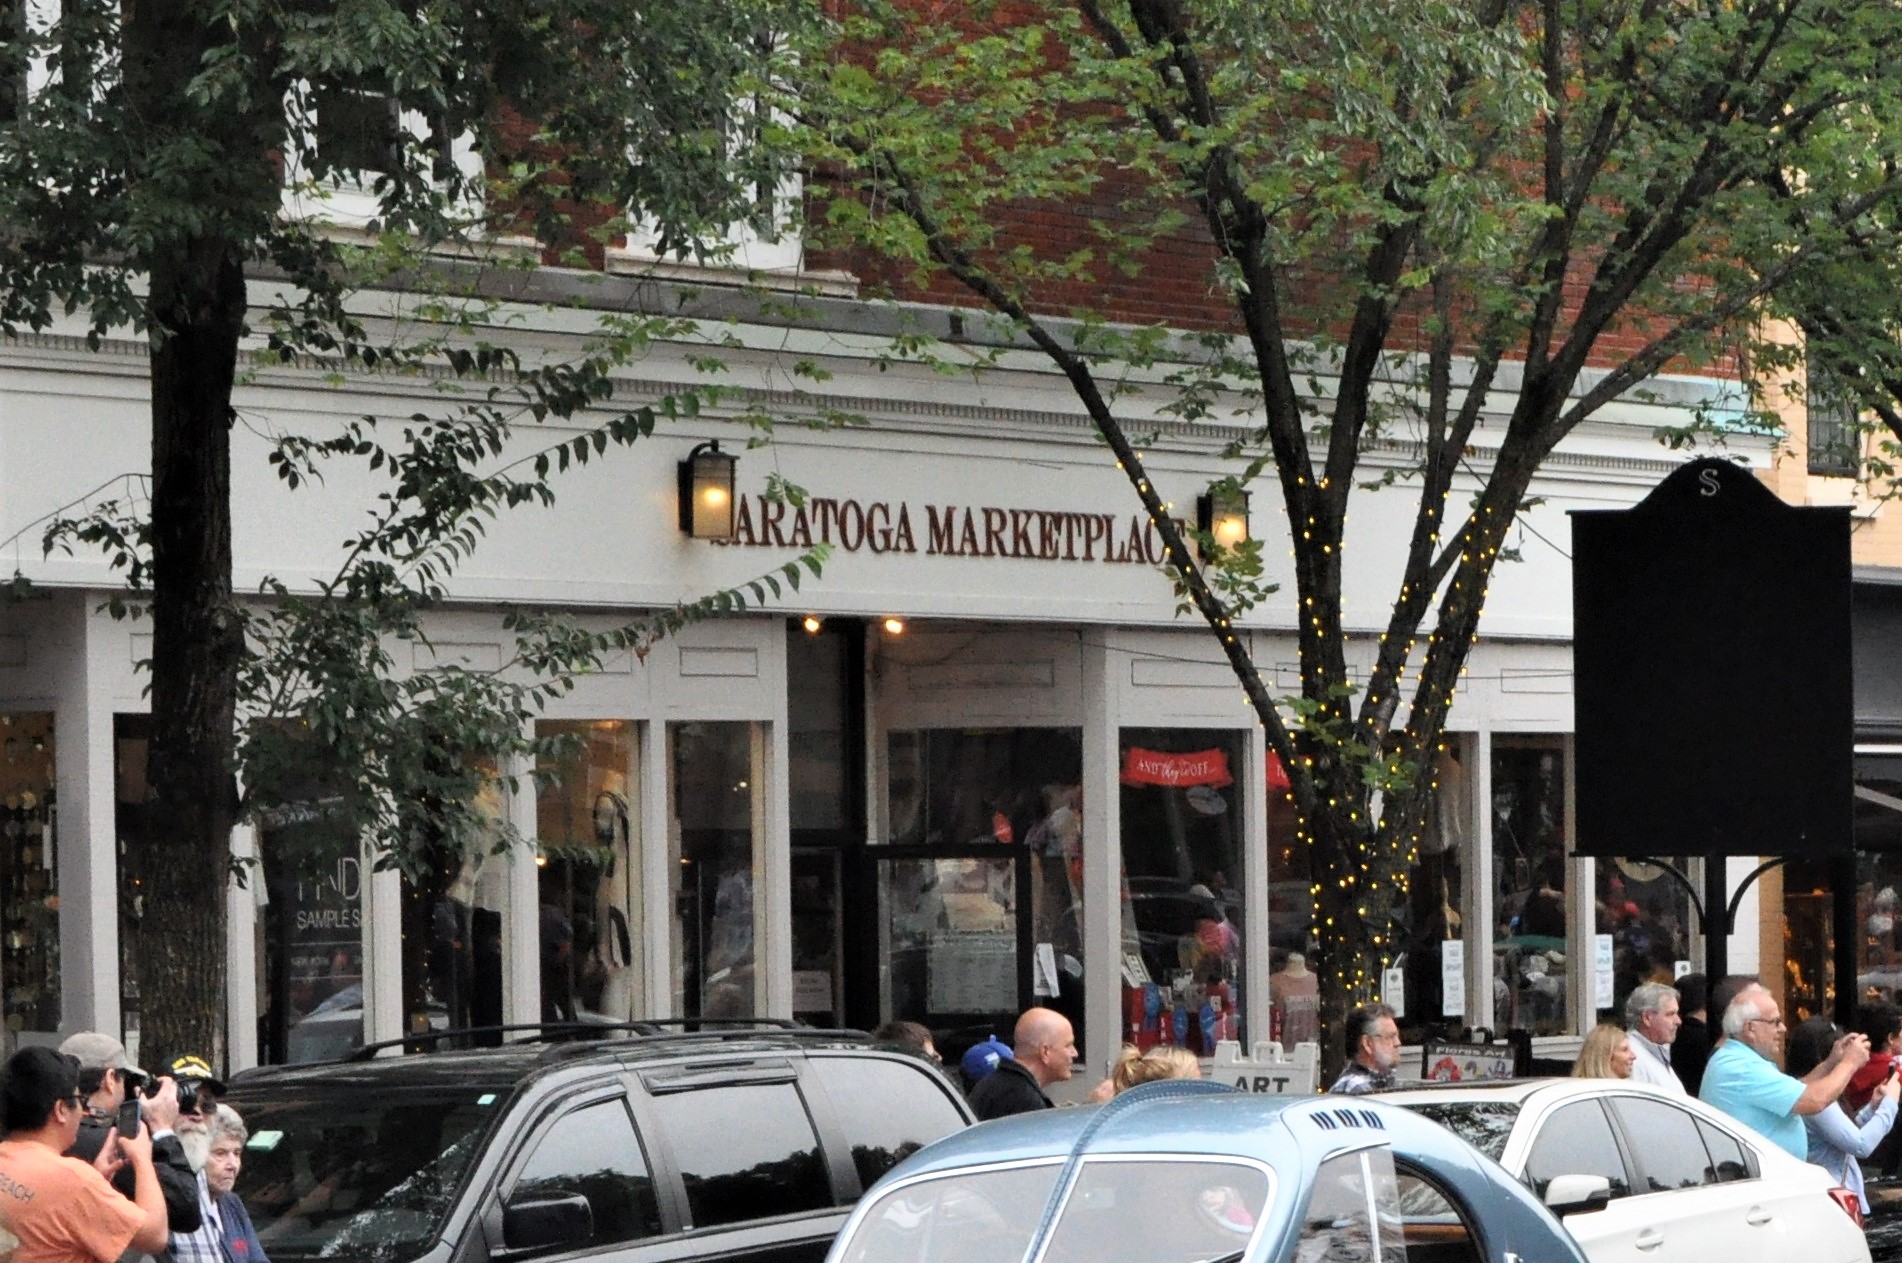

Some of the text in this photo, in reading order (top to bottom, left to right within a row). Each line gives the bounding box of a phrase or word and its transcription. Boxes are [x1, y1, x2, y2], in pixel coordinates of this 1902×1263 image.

[1699, 468, 1720, 496] S
[710, 493, 917, 553] ARATOGA
[297, 910, 349, 929] SAMPLE
[1235, 1076, 1290, 1093] ART
